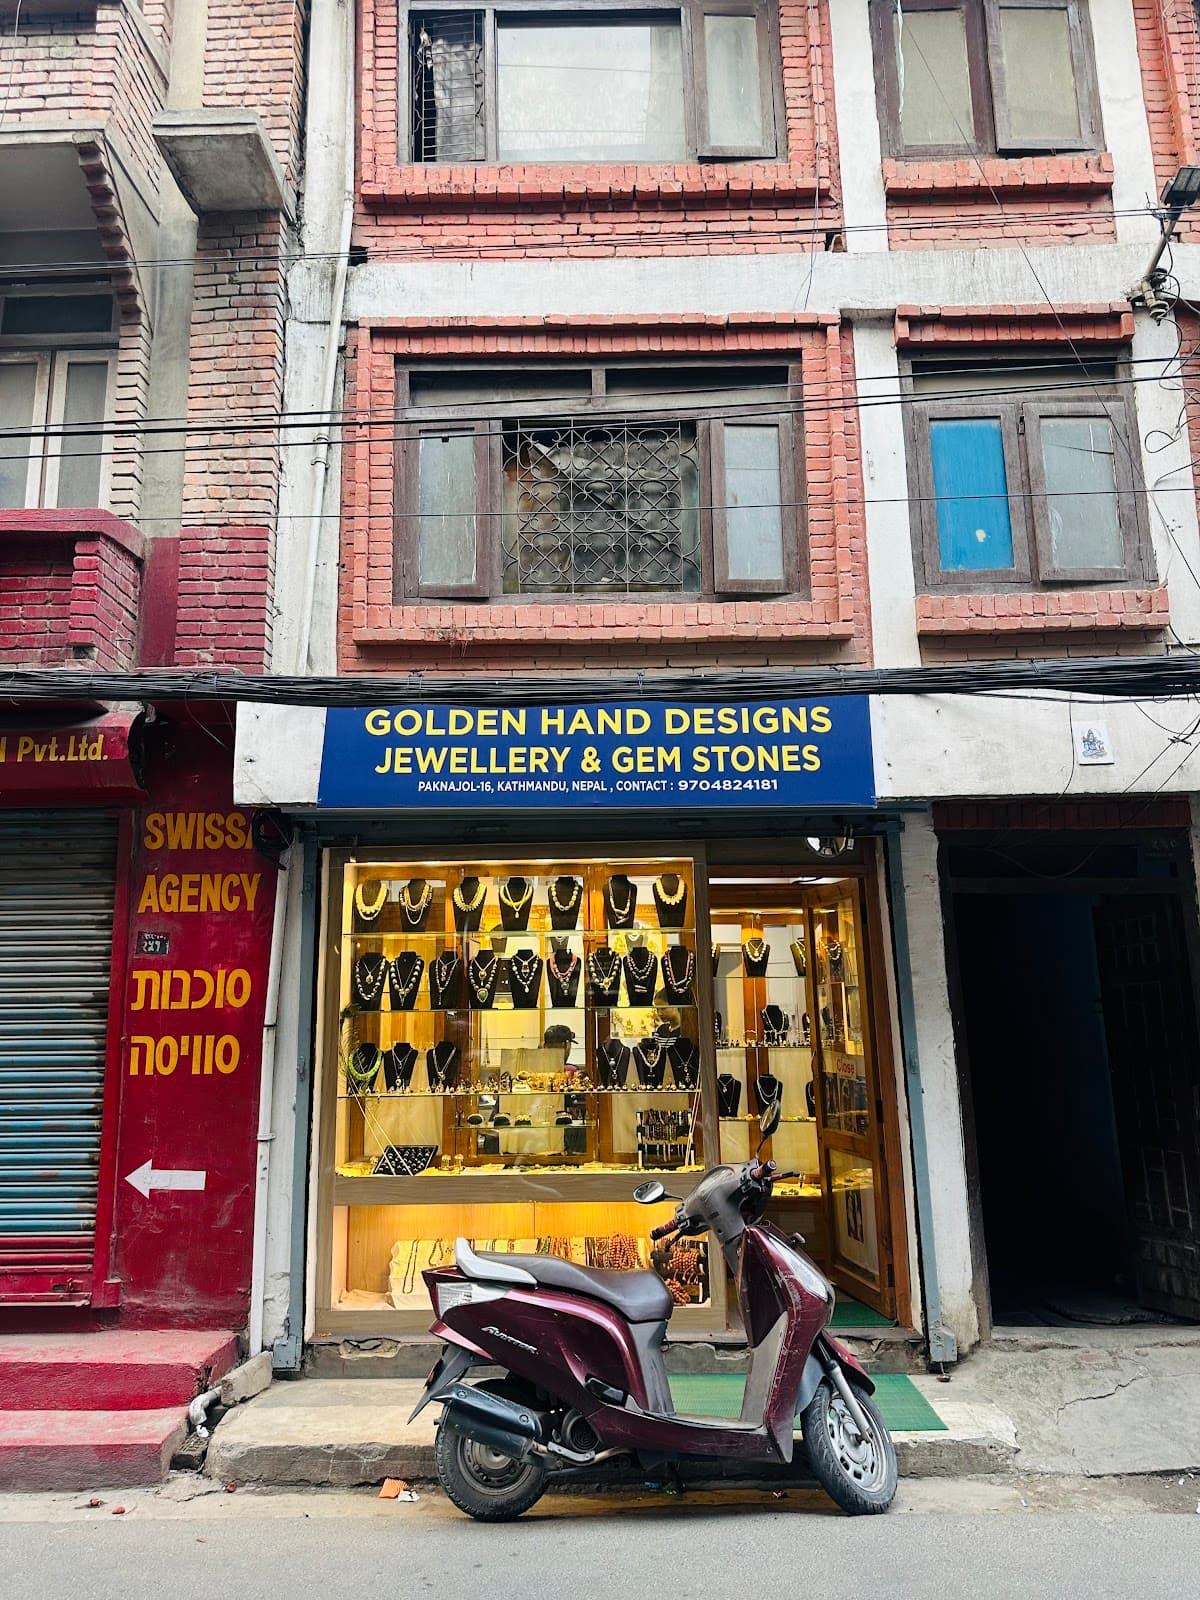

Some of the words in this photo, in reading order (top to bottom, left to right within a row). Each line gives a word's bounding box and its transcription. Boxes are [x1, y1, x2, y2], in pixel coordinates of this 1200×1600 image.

[364, 708, 526, 736] GOLDEN
[541, 708, 651, 735] HAND
[665, 706, 832, 735] DESIGNS
[374, 746, 571, 774] JEWELLERY
[580, 746, 601, 774] &
[611, 746, 681, 773] GEM
[692, 744, 821, 773] STONES
[418, 780, 494, 793] PAKNAJOL-16,
[497, 780, 569, 793] KATHMANDU,
[616, 780, 667, 791] CONTACT
[678, 779, 778, 791] 9704824181
[137, 873, 262, 913] AGENCY
[130, 968, 252, 1011] סוכנות
[129, 1034, 240, 1076] סוויסה
